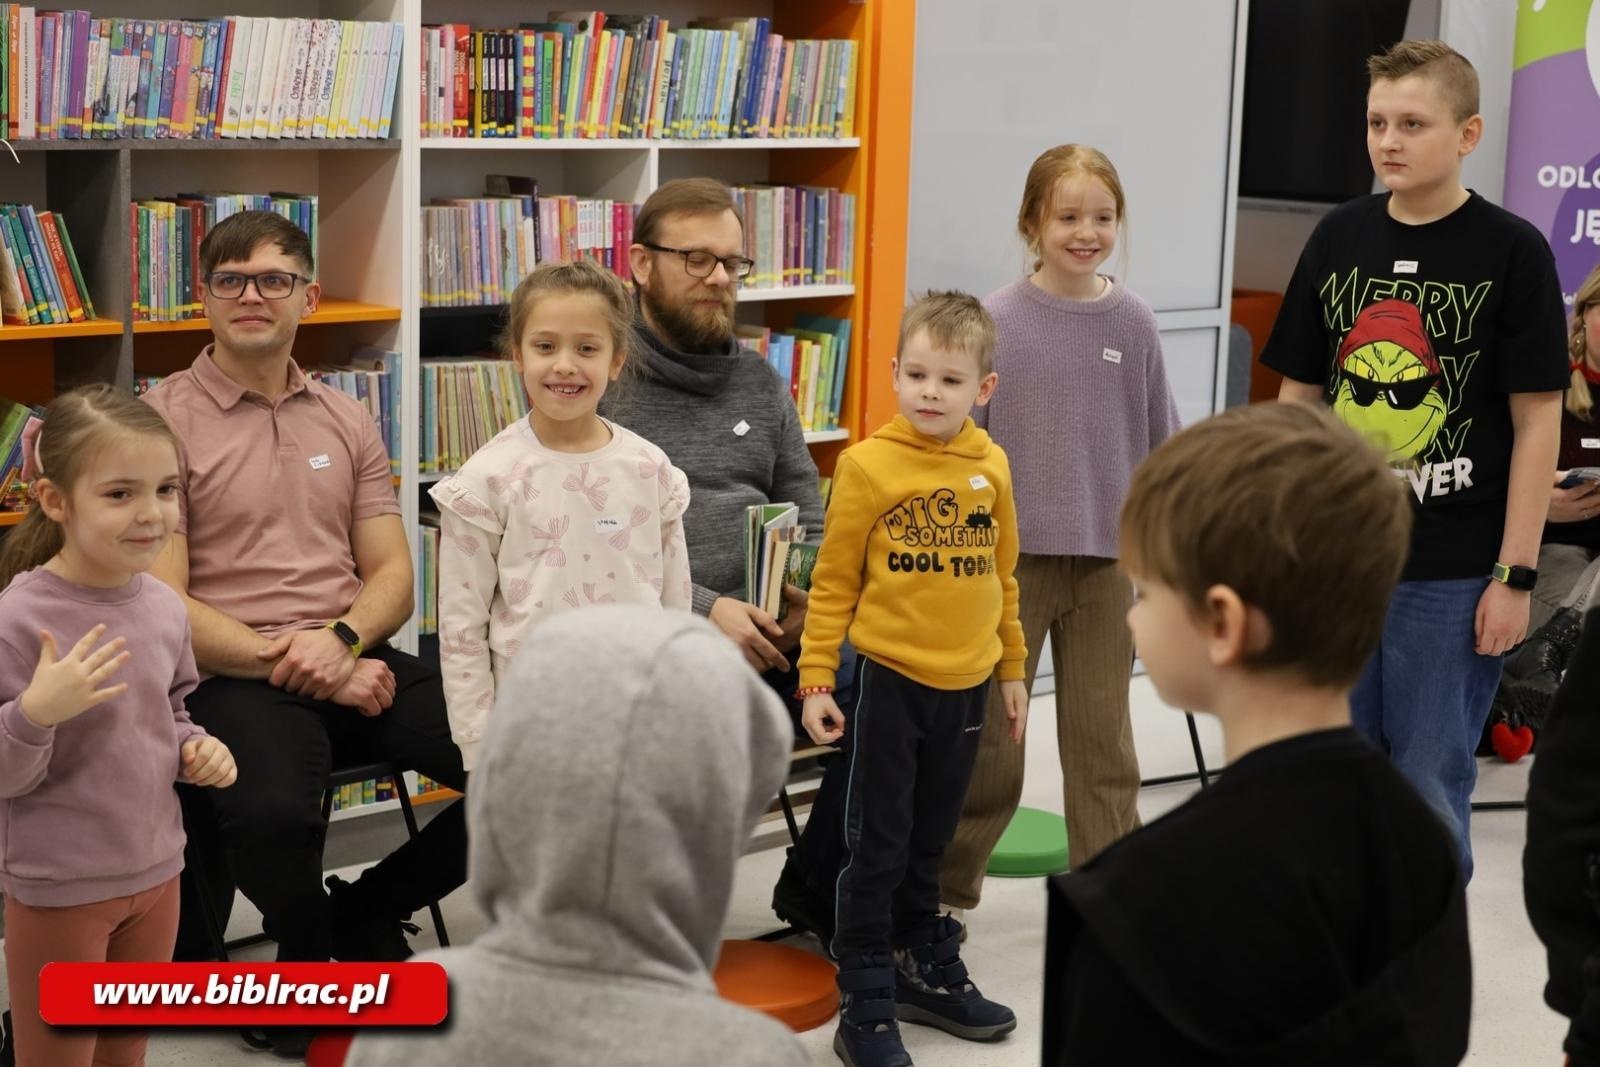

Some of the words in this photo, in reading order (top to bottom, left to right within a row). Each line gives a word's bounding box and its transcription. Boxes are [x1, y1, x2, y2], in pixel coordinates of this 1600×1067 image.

[1392, 456, 1475, 505] VER
[883, 487, 959, 542] BIG
[887, 551, 945, 573] COOL
